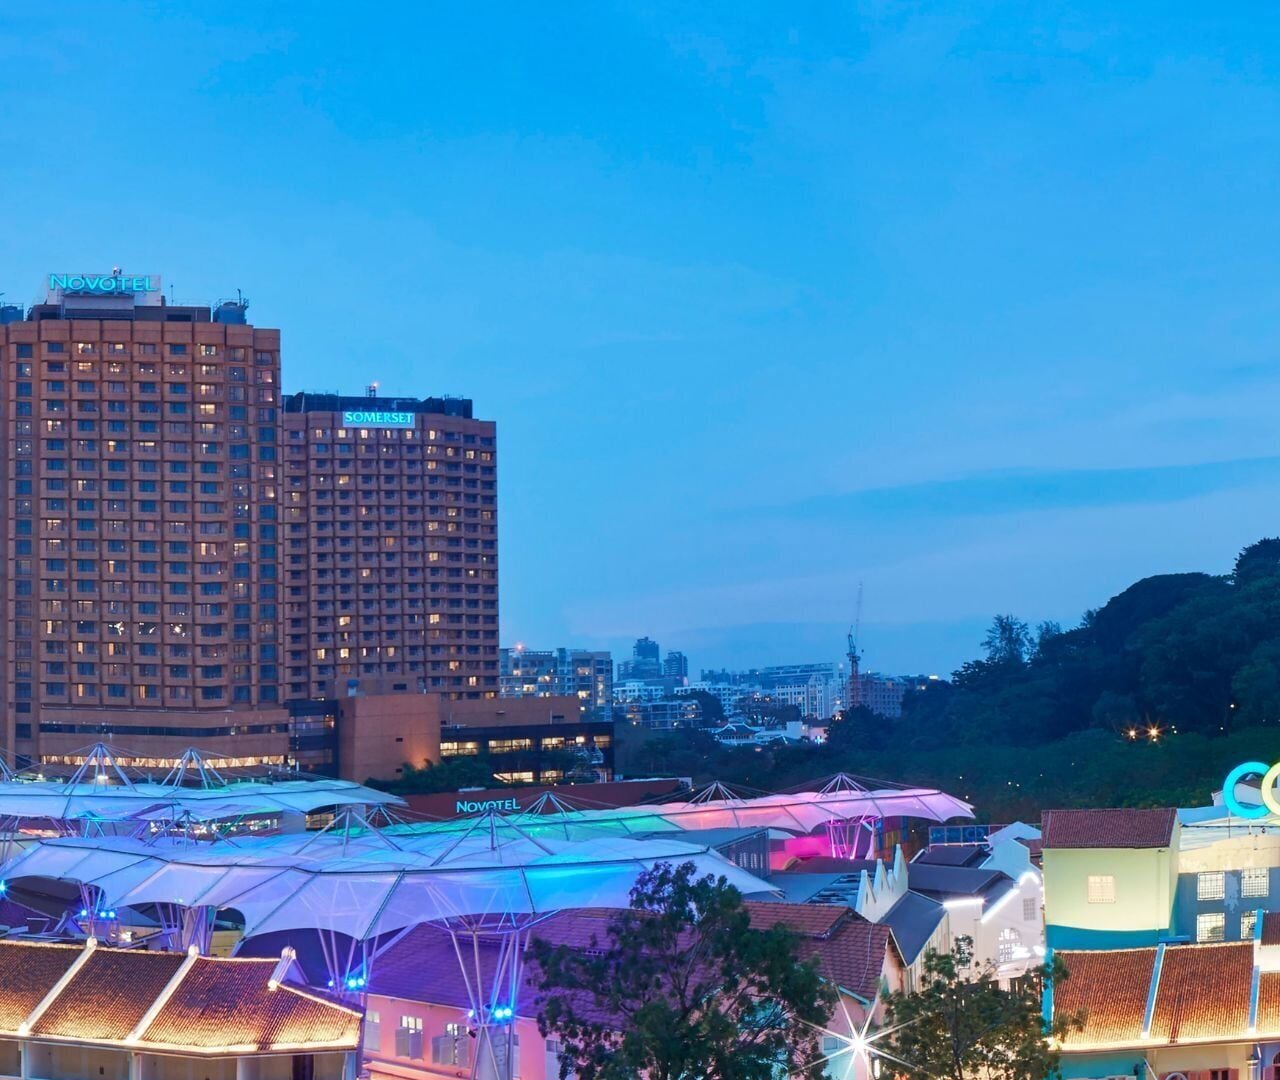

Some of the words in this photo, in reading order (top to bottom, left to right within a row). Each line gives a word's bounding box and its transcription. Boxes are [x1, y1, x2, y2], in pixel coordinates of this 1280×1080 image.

[49, 274, 158, 291] NOVOTEL
[345, 412, 413, 424] SOMERSET
[456, 797, 521, 813] NOVOTEL
